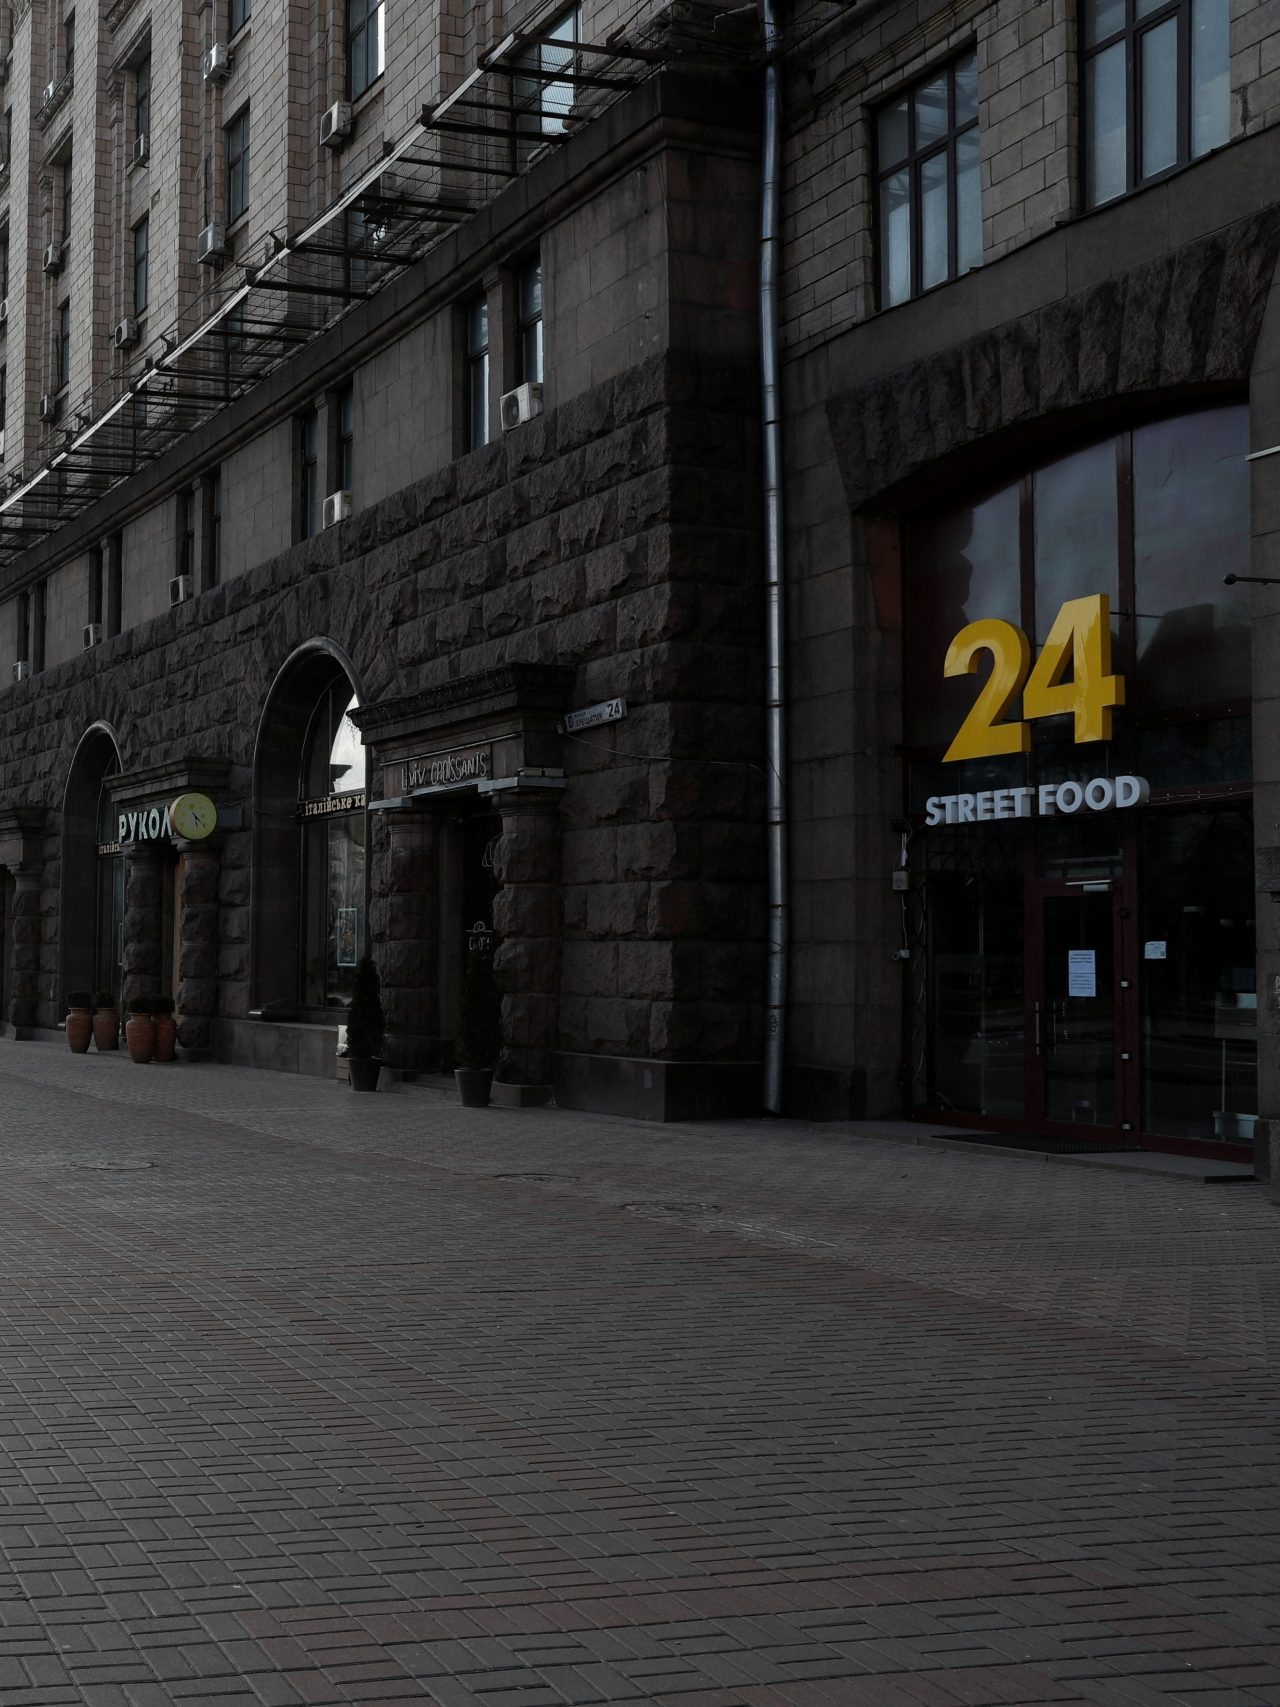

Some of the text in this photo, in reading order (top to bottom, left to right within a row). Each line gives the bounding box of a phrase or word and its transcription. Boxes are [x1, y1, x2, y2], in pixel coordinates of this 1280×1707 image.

[941, 594, 1126, 763] 24
[607, 701, 621, 718] 24
[925, 775, 1151, 827] STREET FOOD
[118, 806, 176, 844] РУКОЛ
